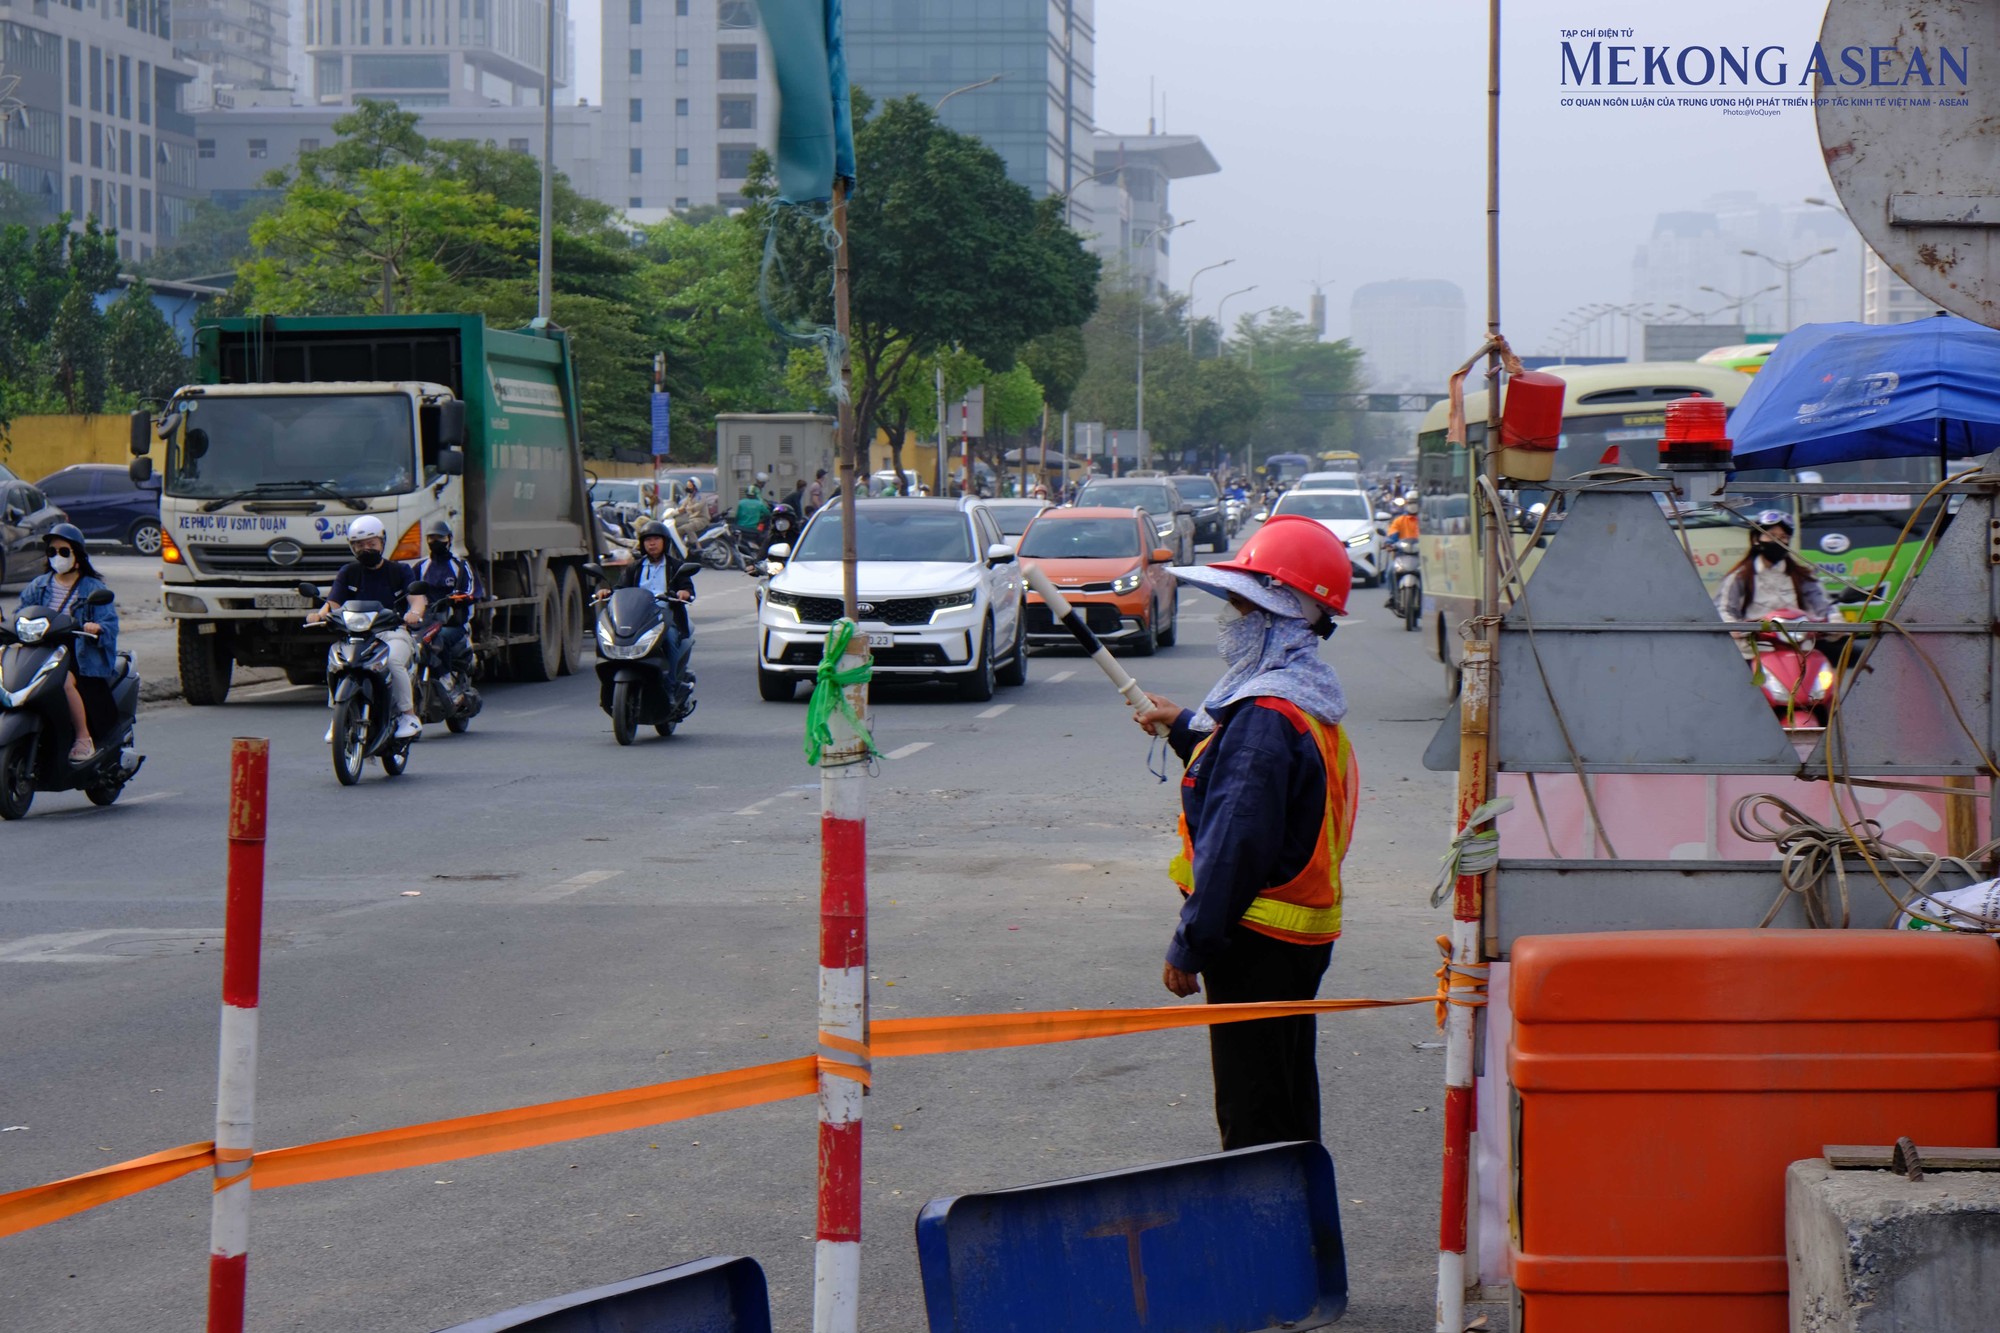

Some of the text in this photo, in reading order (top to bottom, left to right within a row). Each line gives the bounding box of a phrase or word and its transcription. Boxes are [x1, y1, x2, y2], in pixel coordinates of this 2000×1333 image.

[179, 515, 287, 534] XE PHỤC VỤ VSMT QUẬN
